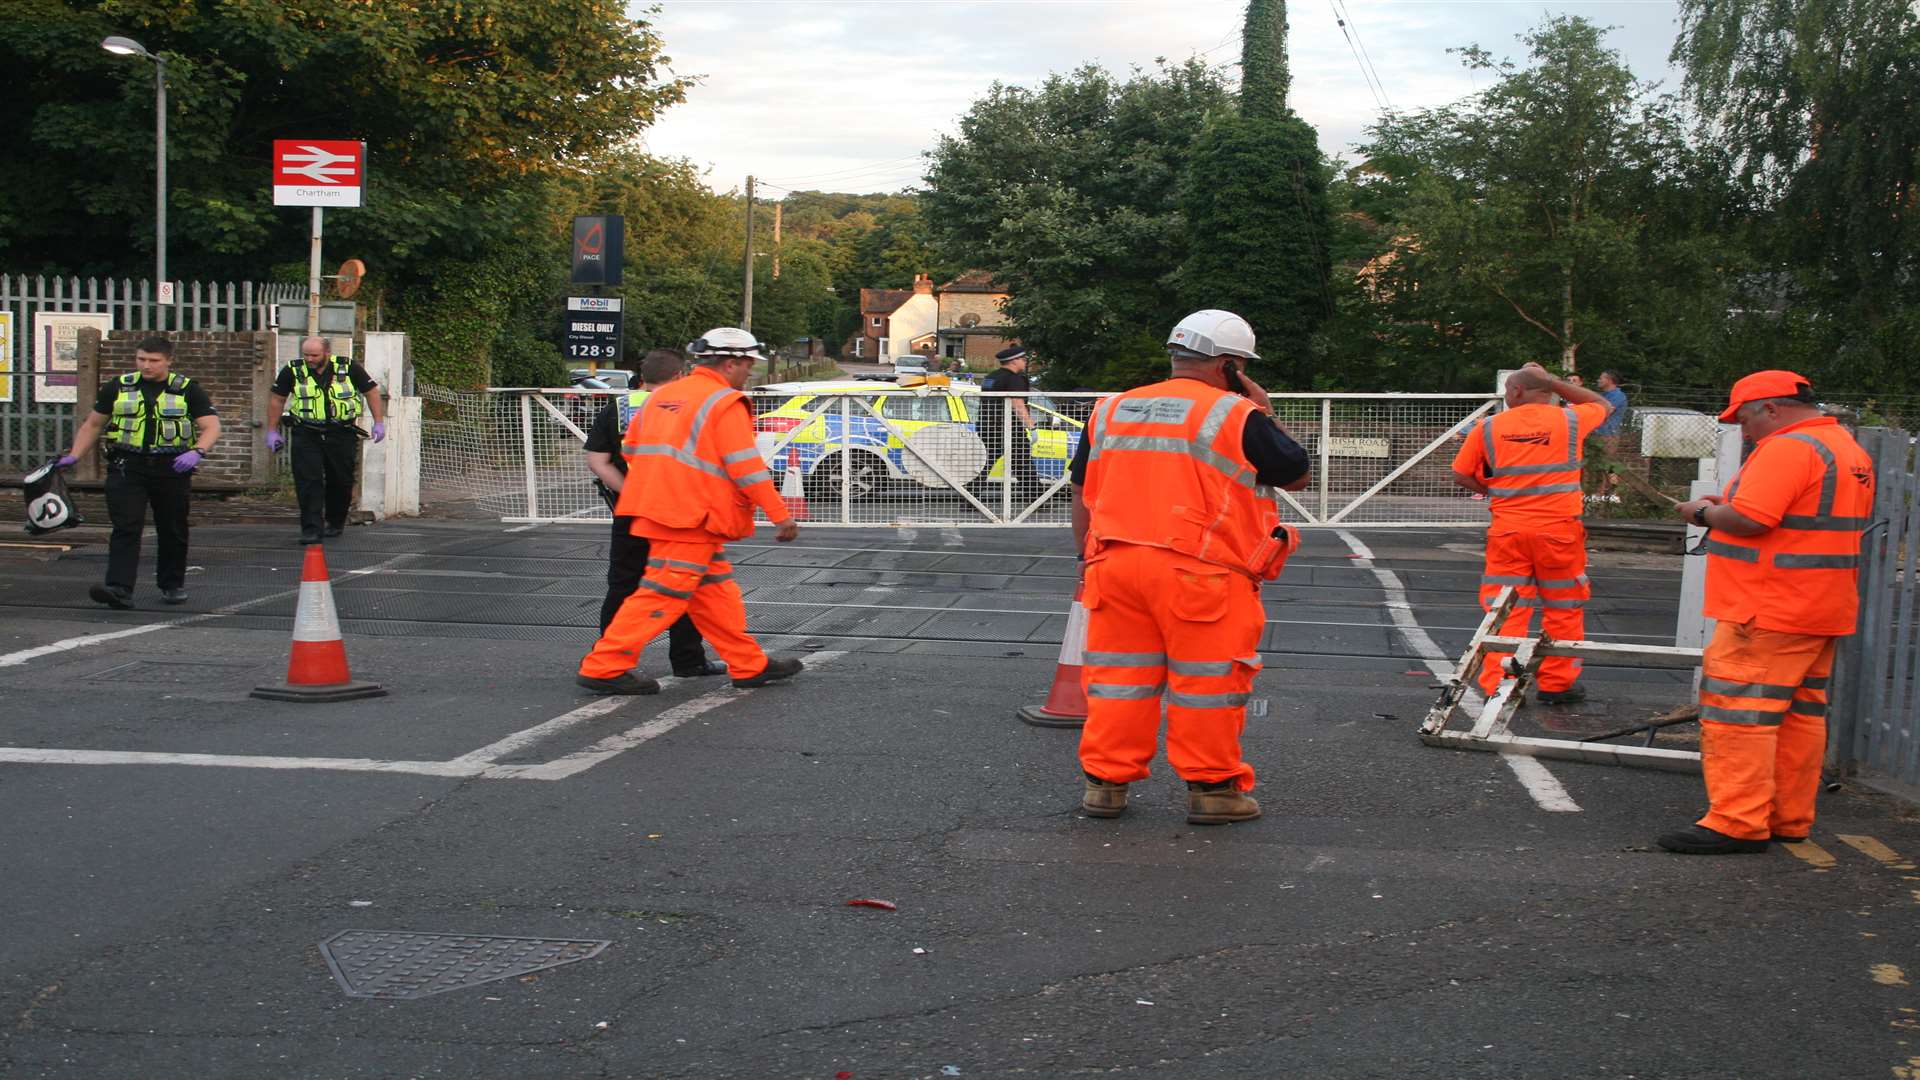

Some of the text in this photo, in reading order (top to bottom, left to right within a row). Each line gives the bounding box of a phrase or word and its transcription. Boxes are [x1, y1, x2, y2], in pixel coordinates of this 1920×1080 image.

[296, 188, 341, 197] Chartham
[580, 298, 609, 306] Mobil
[571, 322, 615, 333] DIESEL ONLY
